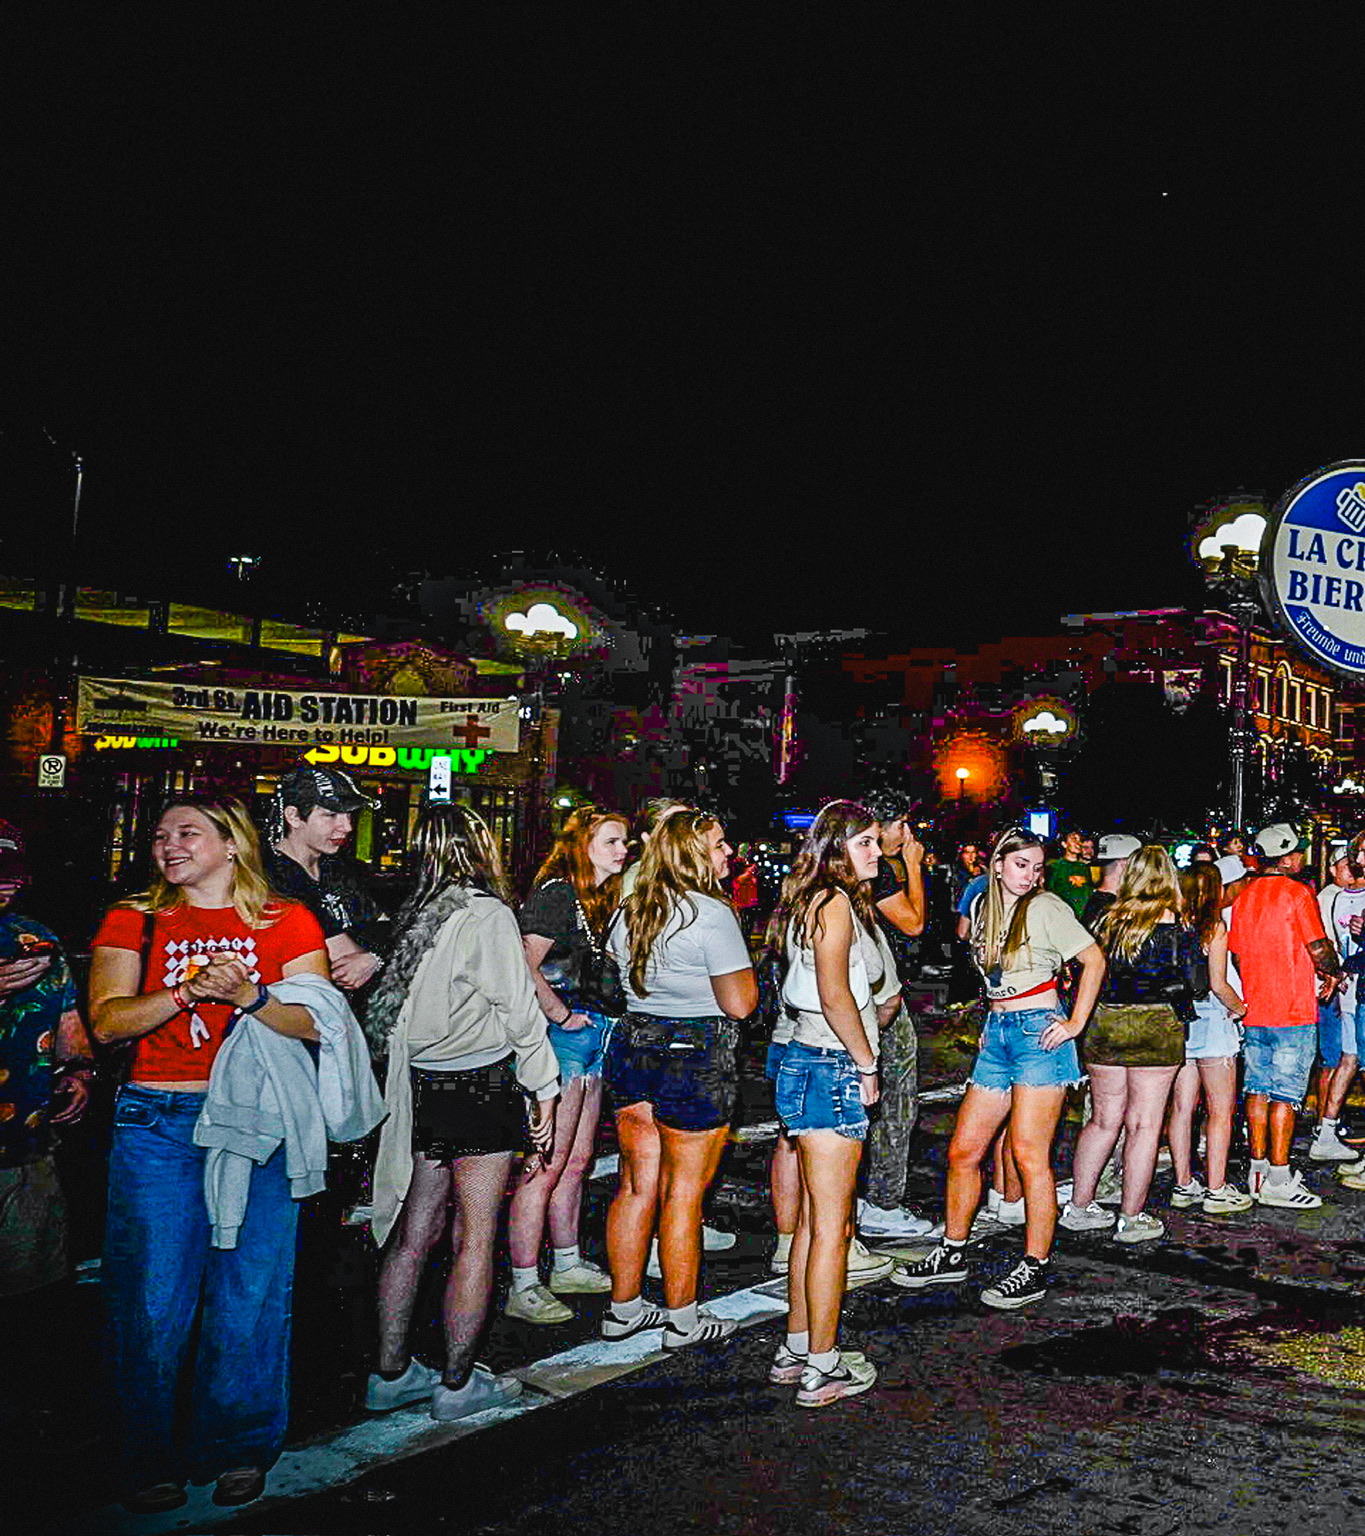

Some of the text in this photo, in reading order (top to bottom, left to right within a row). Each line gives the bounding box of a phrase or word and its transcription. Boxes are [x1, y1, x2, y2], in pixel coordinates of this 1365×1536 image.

[1288, 528, 1327, 565] LA
[1296, 611, 1341, 656] Freunde
[172, 686, 240, 710] 3rd St.
[241, 692, 418, 726] AID STATION
[440, 701, 500, 714] First Aid
[199, 722, 389, 745] We're Here to Help!
